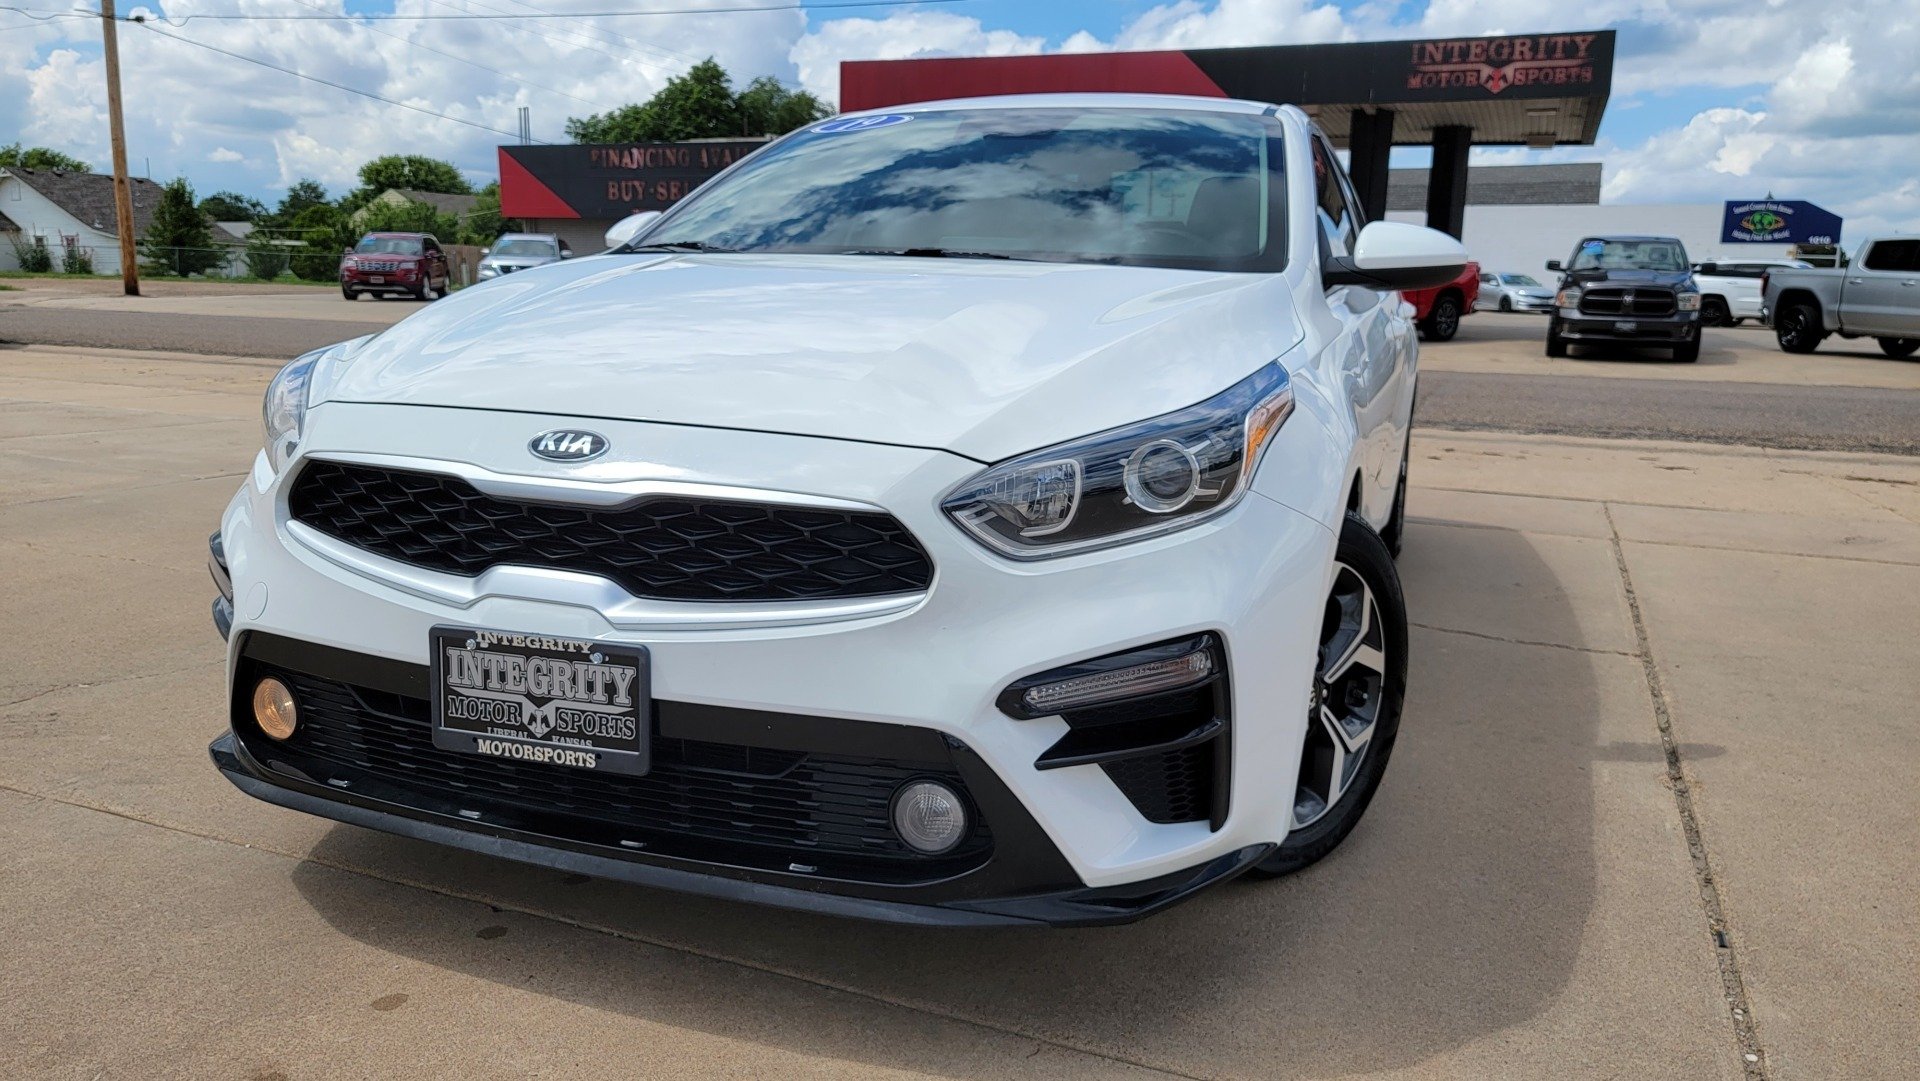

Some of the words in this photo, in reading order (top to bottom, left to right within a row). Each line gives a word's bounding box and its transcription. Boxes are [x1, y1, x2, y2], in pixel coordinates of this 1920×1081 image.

[1411, 35, 1595, 63] INTEGRITY
[1407, 70, 1481, 89] MOTOR
[1514, 66, 1593, 86] SPORTS
[591, 147, 690, 169] FINANCING
[537, 432, 594, 455] KIA
[475, 631, 594, 655] INTEGRITY
[447, 647, 637, 706] INTEGRITY
[448, 696, 522, 725] MOTOR
[557, 709, 636, 740] SPORTS
[477, 738, 596, 768] MOTORSPORTS
[552, 735, 593, 748] KANSAS
